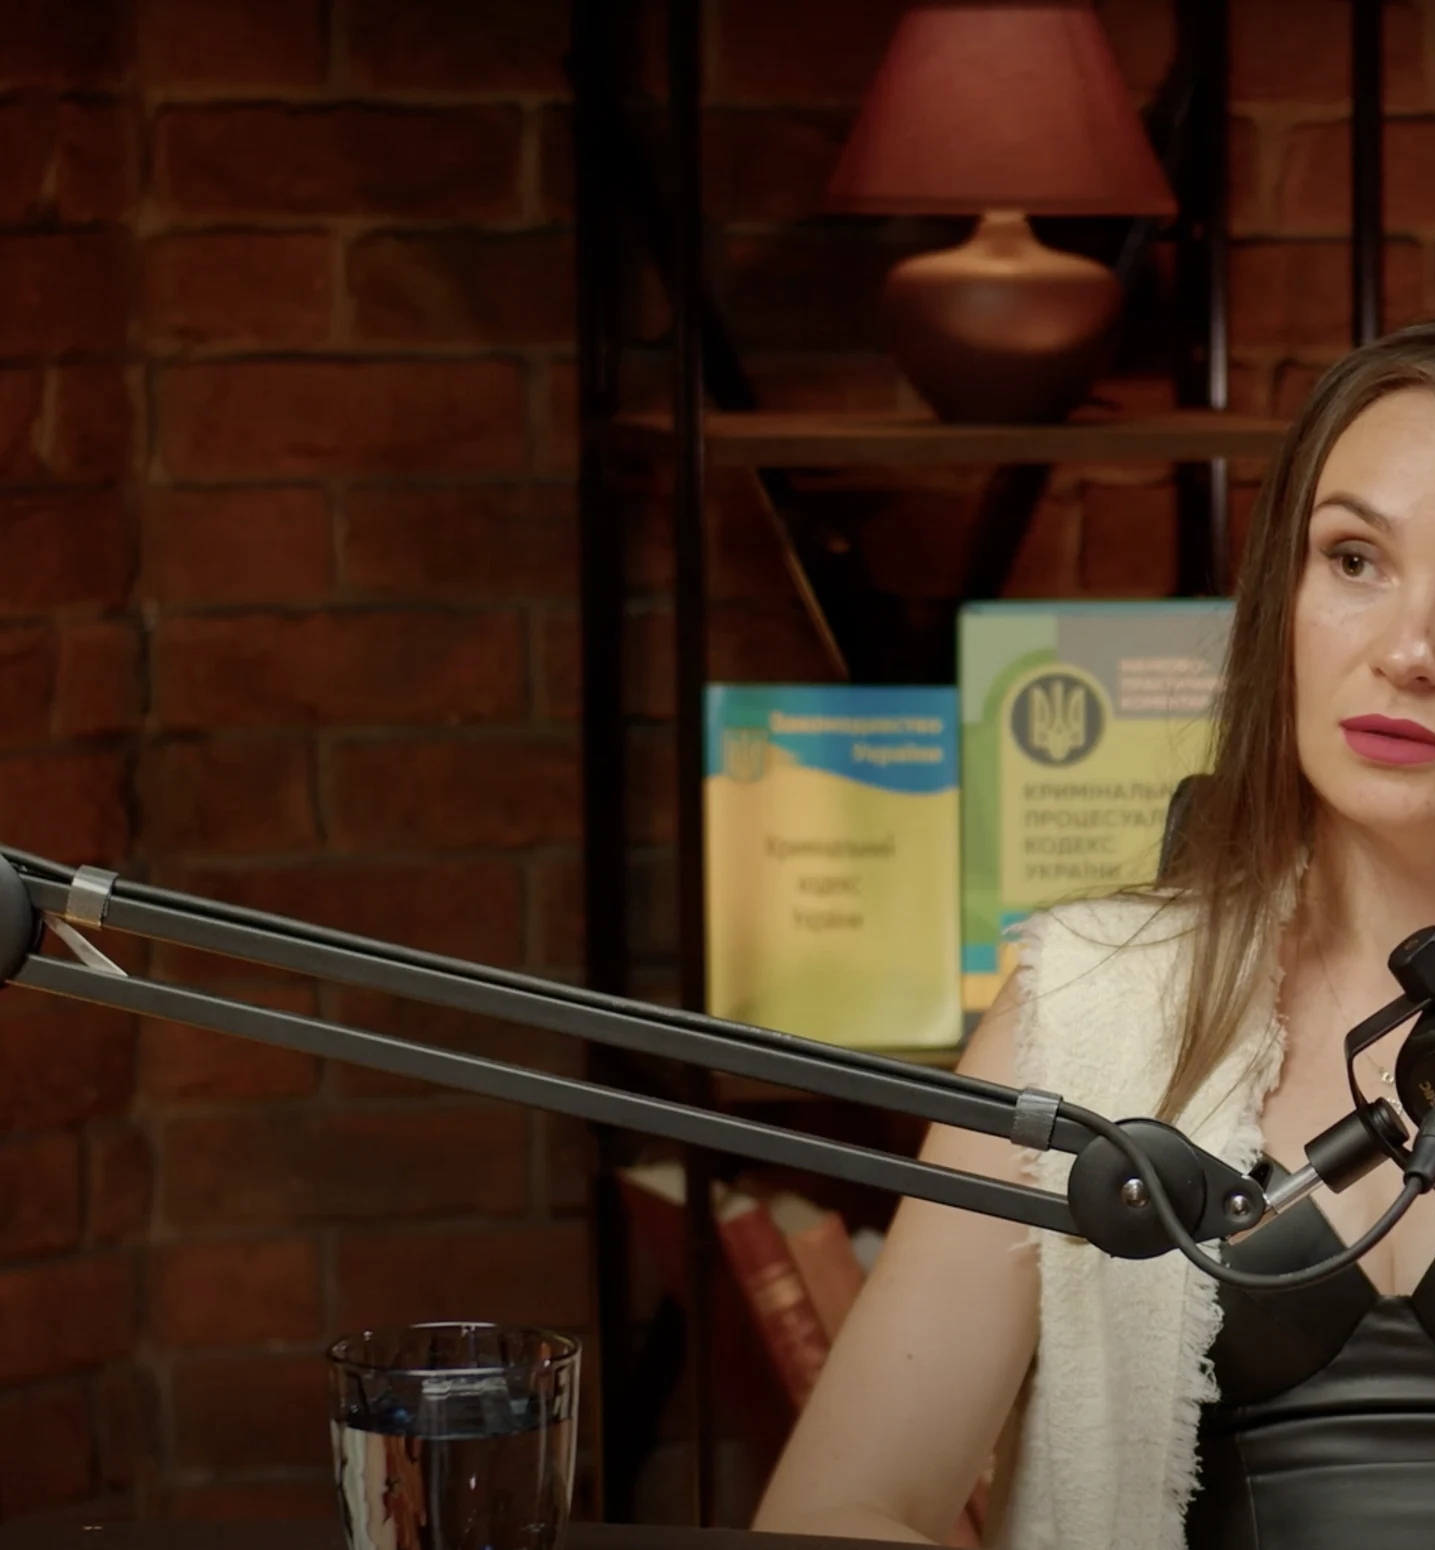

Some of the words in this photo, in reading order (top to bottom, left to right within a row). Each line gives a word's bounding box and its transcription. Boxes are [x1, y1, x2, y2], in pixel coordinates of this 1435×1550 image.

[1024, 782, 1173, 801] КРИМІНАЛЬН
[1024, 809, 1165, 829] ПРОЦЕСУАЛ
[1024, 835, 1117, 855] КОДЕКС
